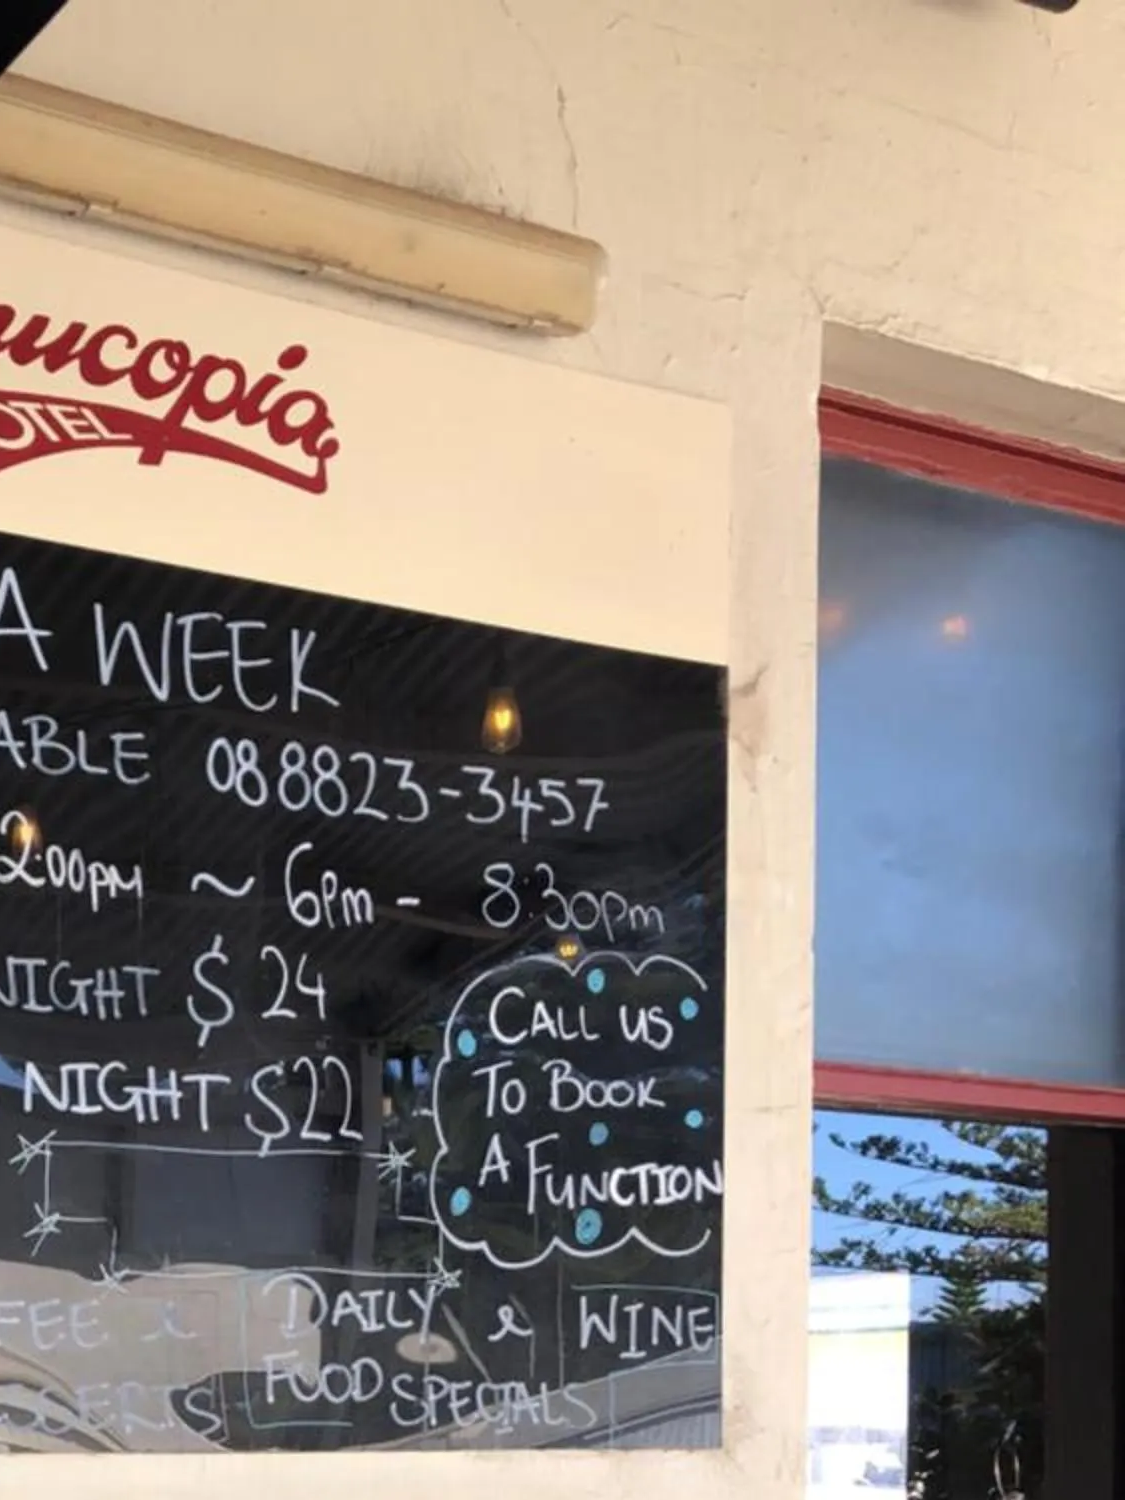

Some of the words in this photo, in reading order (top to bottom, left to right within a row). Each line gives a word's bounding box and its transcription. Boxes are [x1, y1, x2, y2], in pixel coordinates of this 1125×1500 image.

[94, 602, 341, 713] WEEK
[488, 985, 601, 1046] CALL
[23, 1061, 234, 1132] NIGHT
[243, 1054, 364, 1158] $22
[471, 1059, 528, 1119] TO
[540, 1058, 667, 1113] BOOK
[477, 1131, 511, 1188] A
[523, 1131, 724, 1216] FUNCTION
[262, 1272, 436, 1345] DAILY
[580, 1293, 714, 1360] WINE
[263, 1349, 385, 1406] FOOD
[389, 1372, 598, 1435] SPECIALS
